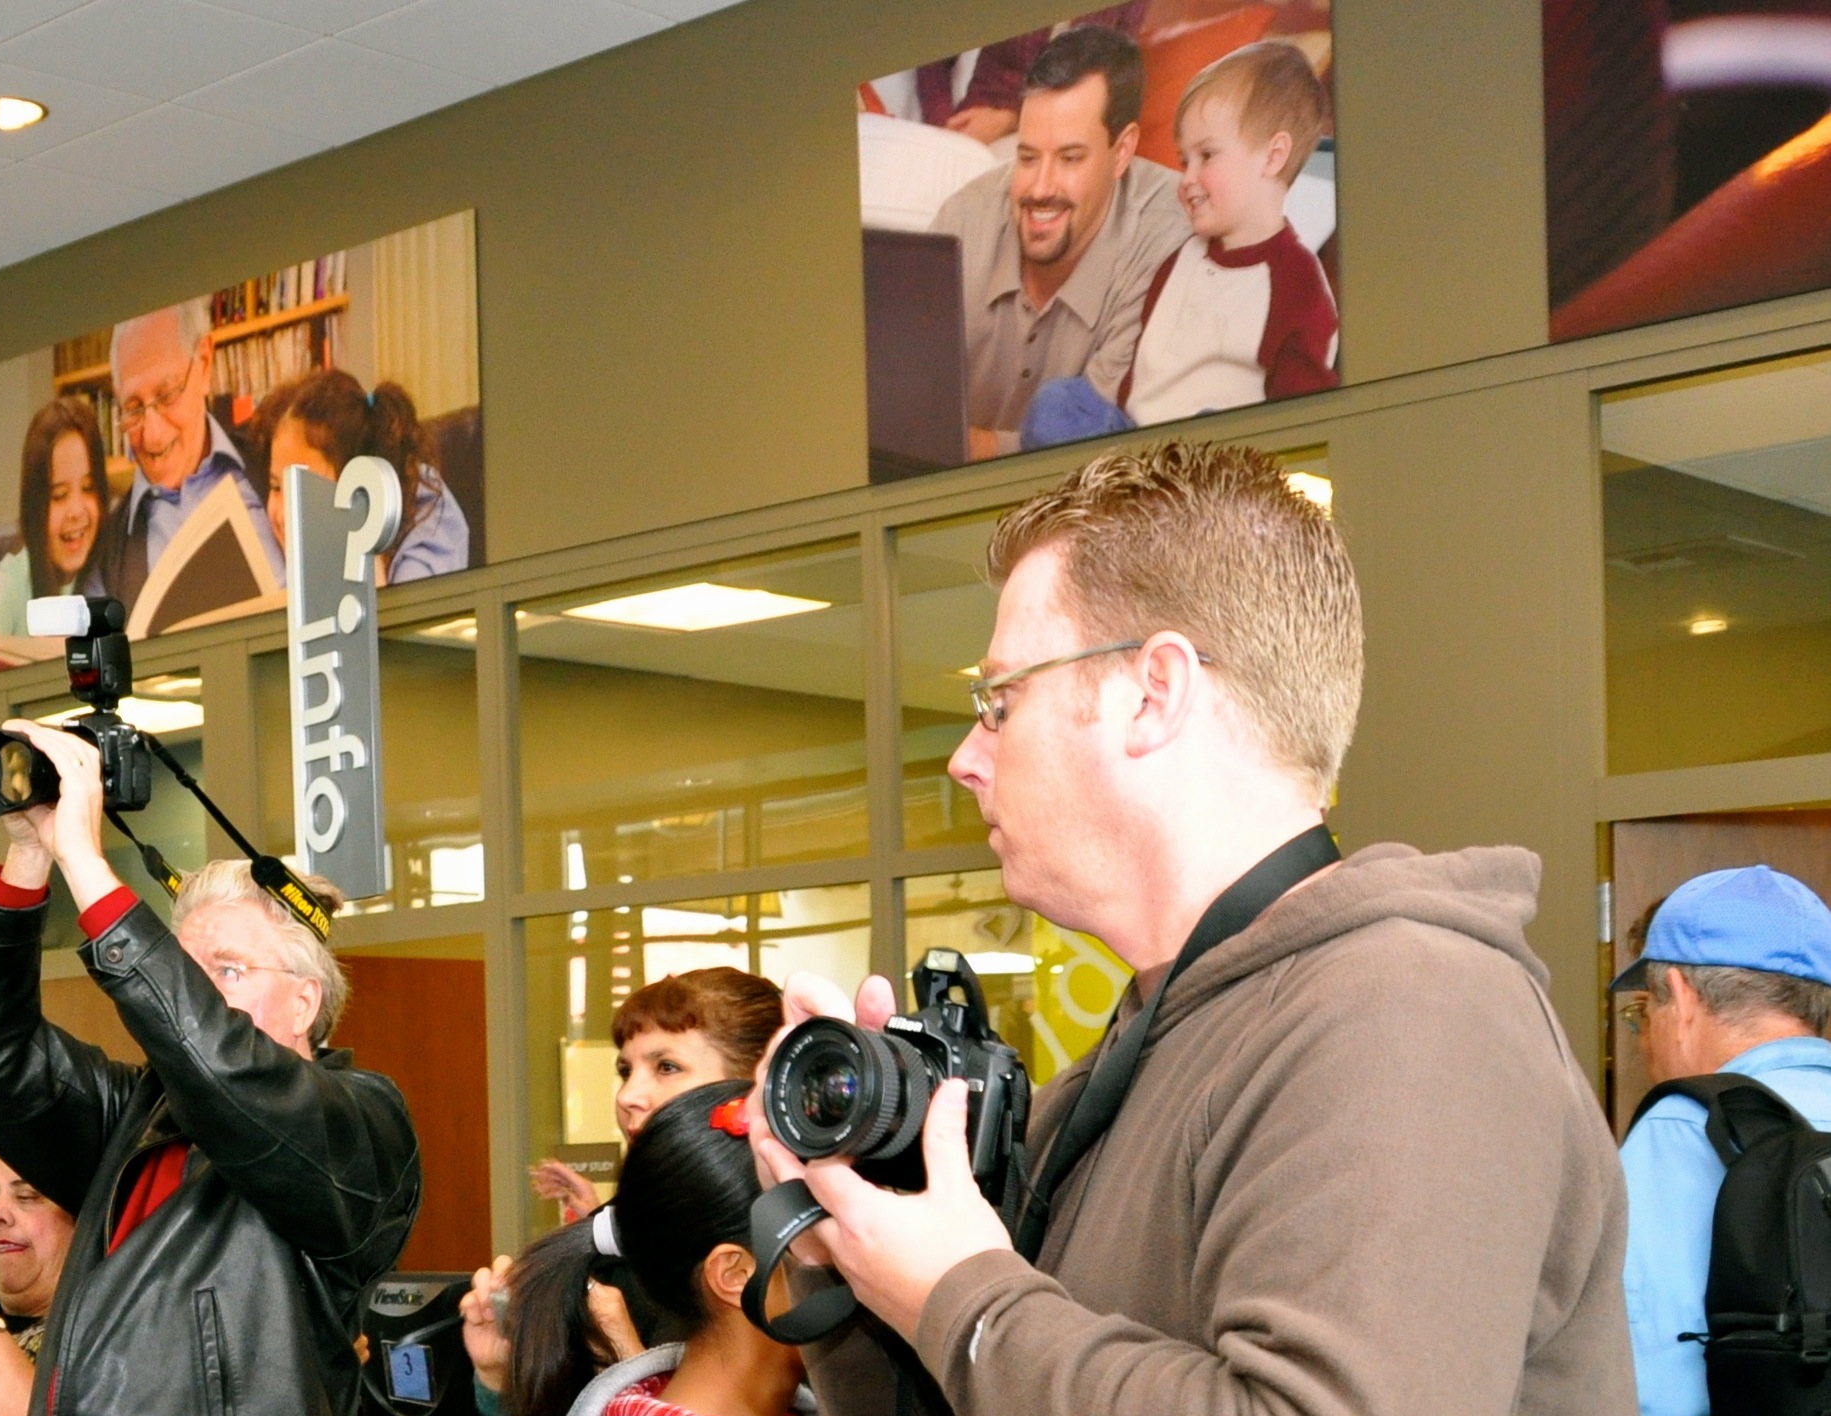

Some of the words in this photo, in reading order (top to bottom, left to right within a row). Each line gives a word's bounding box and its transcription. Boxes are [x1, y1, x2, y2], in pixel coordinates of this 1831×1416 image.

[297, 594, 368, 853] info
[279, 882, 314, 917] Nikon
[887, 1016, 924, 1032] Nikon
[374, 1287, 425, 1306] ViewSonic
[401, 1351, 413, 1376] 3
